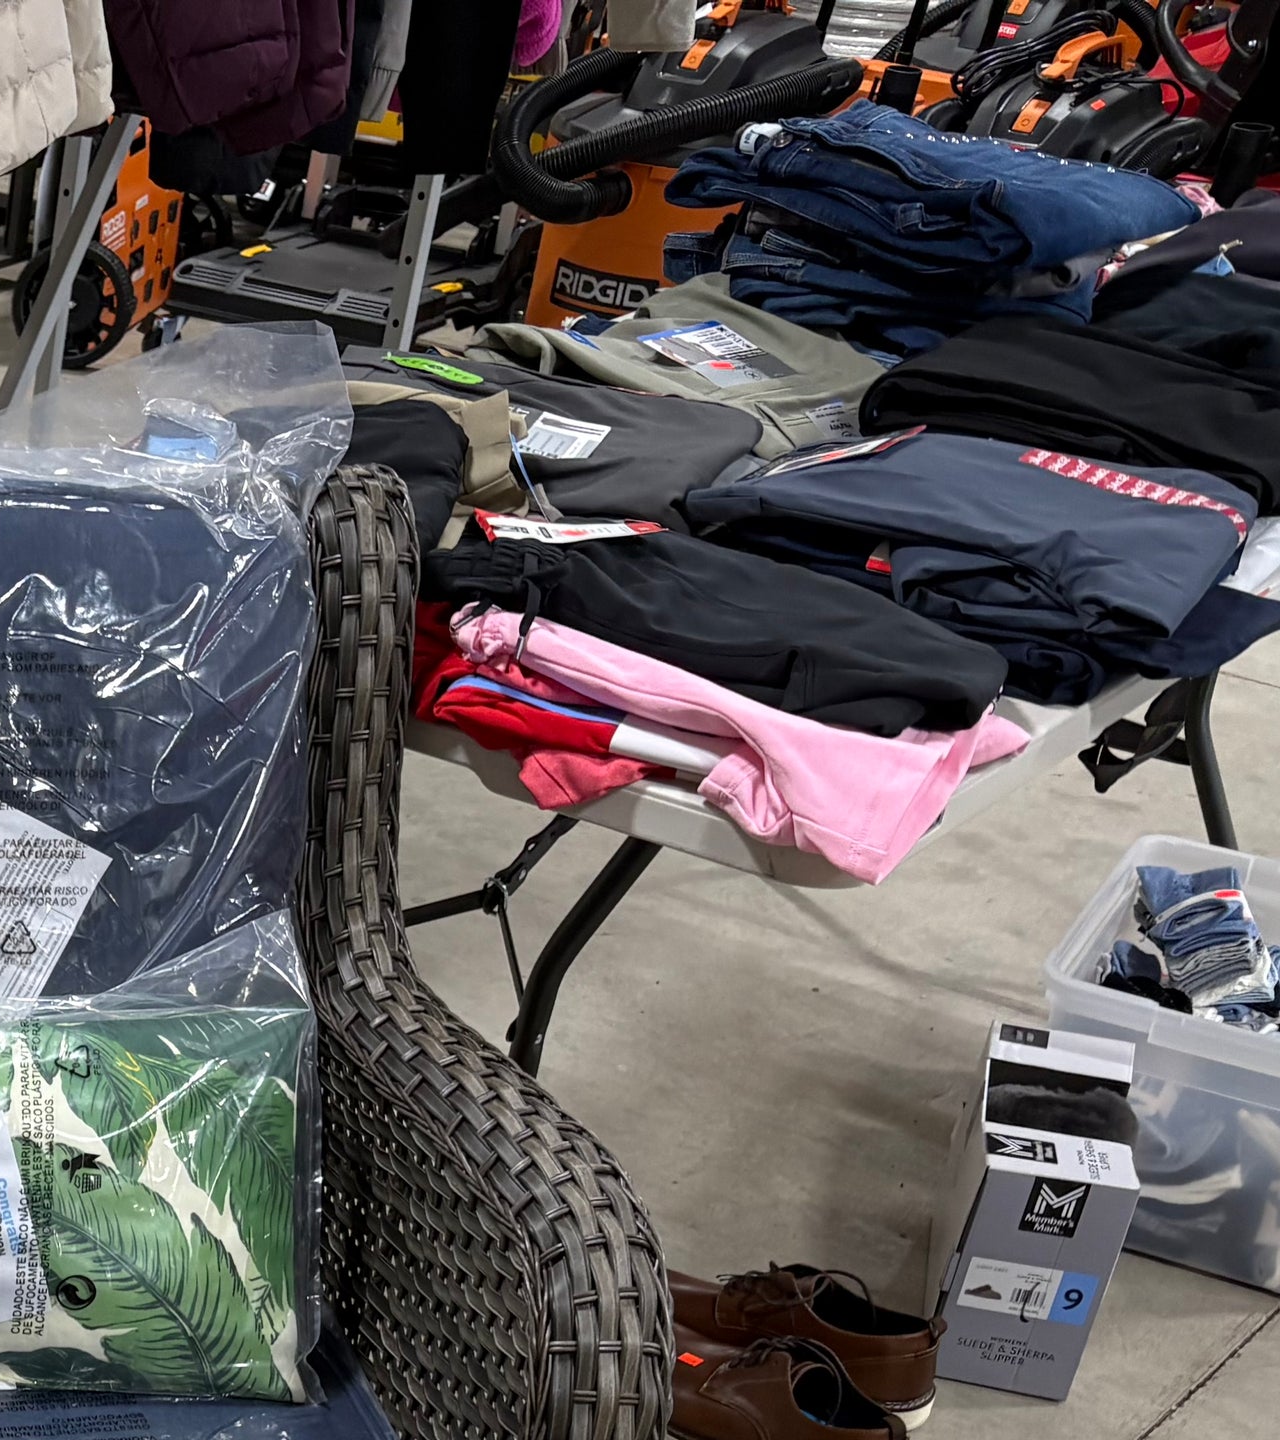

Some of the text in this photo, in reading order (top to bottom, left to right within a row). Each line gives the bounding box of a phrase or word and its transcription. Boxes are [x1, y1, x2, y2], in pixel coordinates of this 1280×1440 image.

[556, 265, 650, 307] RIDGID
[55, 886, 89, 896] RISCO
[33, 1108, 43, 1139] SACO
[1062, 1288, 1083, 1310] 9
